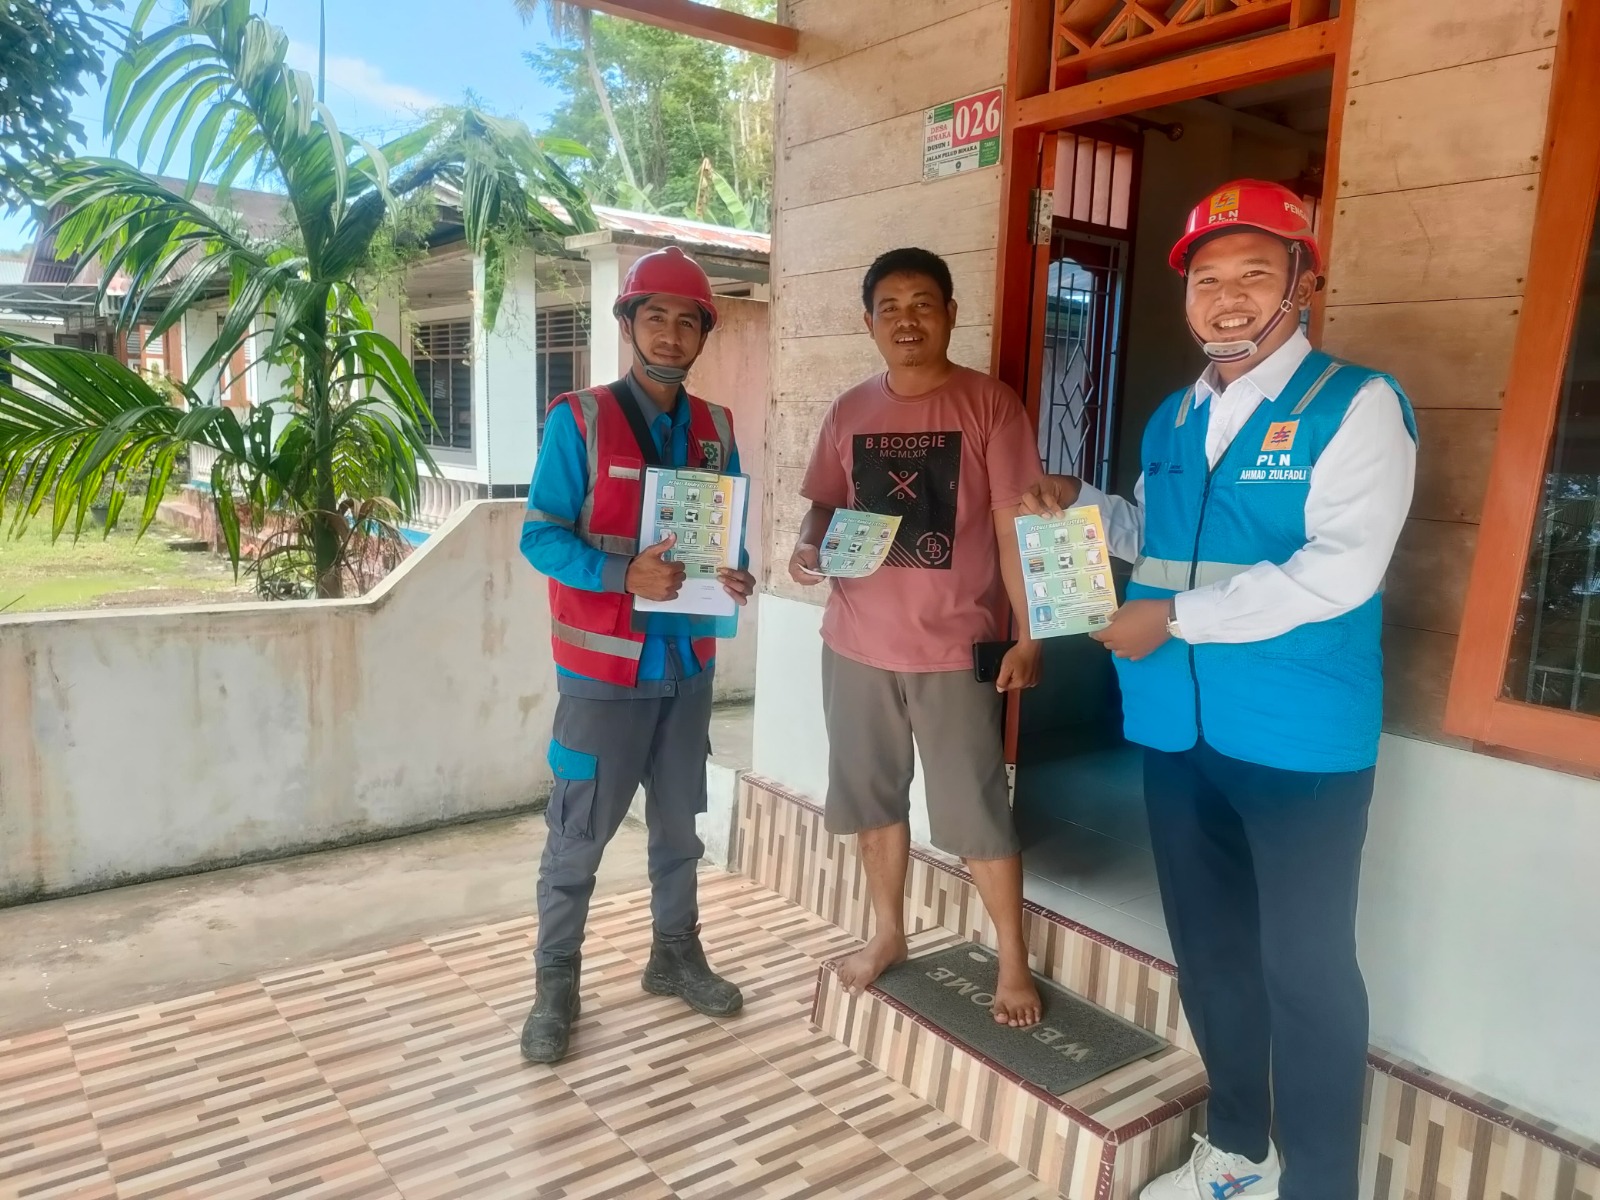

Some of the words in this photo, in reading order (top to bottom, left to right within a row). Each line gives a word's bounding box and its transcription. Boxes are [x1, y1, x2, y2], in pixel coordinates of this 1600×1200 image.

[955, 95, 1000, 140] 026
[930, 124, 948, 134] DESA
[927, 142, 946, 152] DUSUN
[926, 153, 942, 162] JALAN
[1208, 209, 1239, 225] PLN
[880, 449, 928, 458] MCMLXIX
[1256, 454, 1291, 466] PLN
[1240, 470, 1266, 480] AHMAD
[1268, 470, 1307, 480] ZULFADLI
